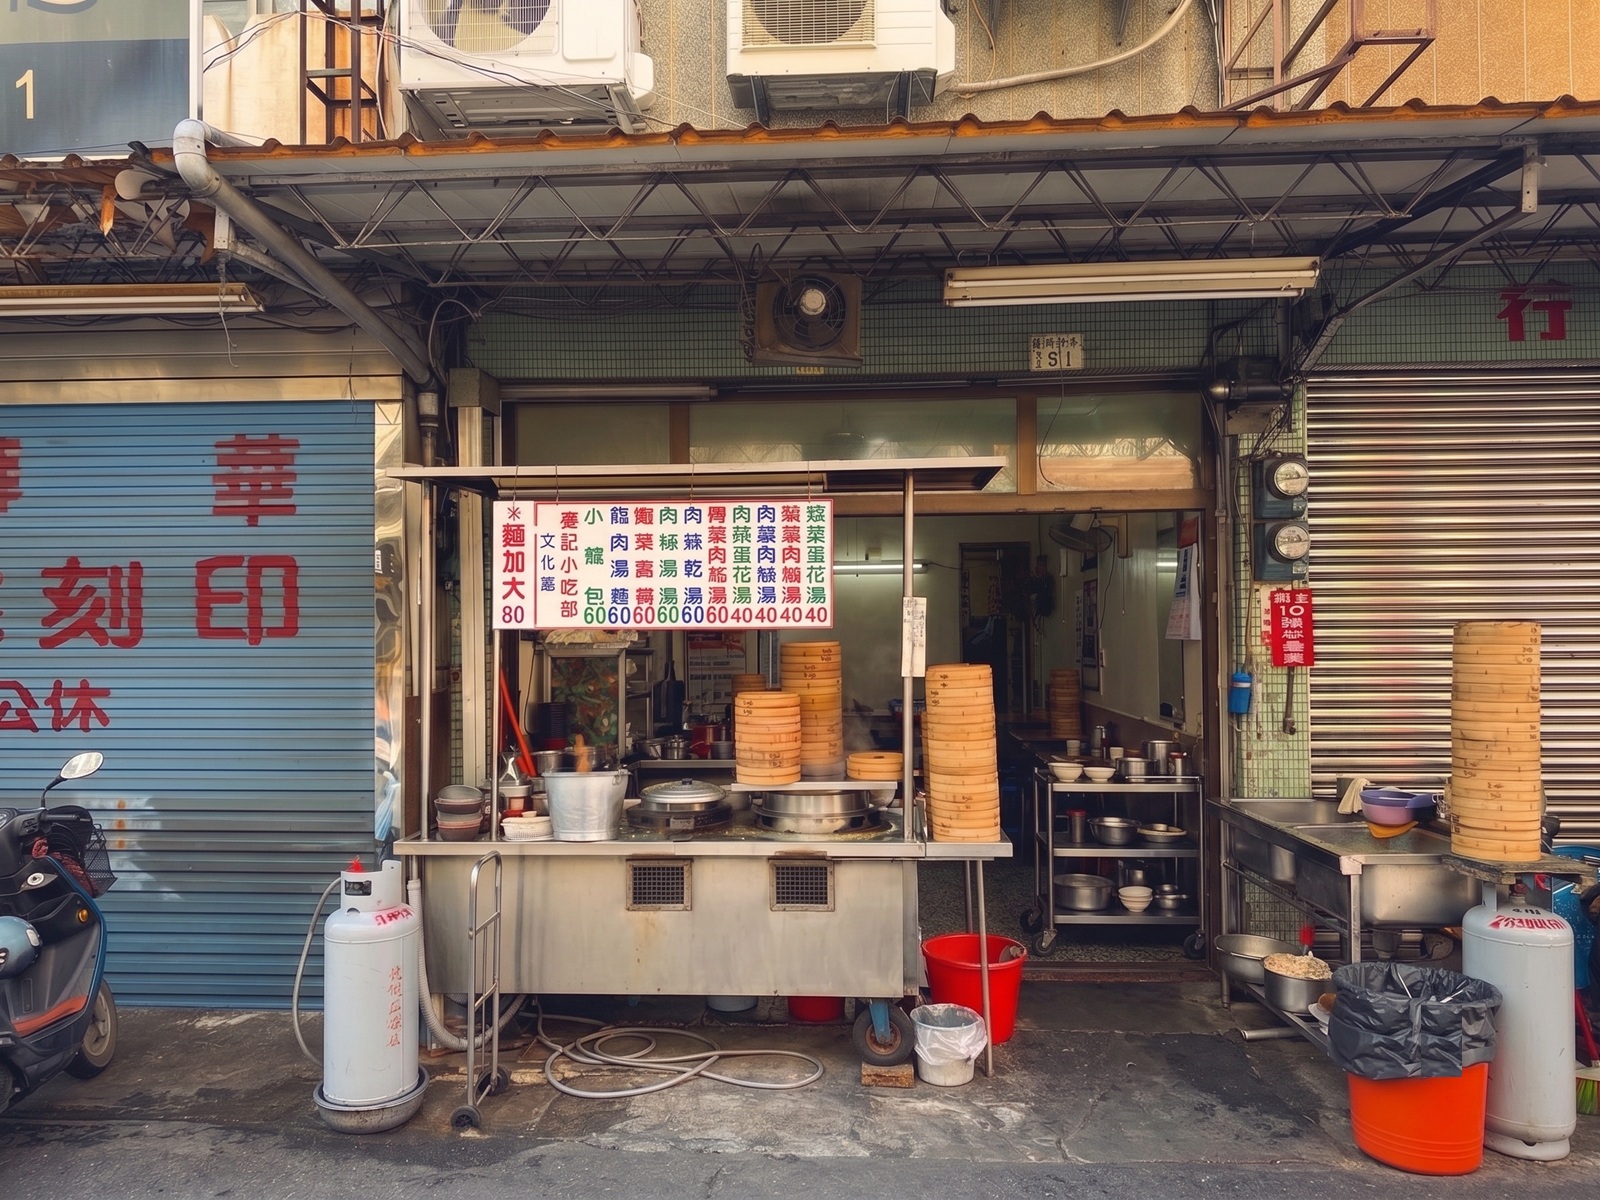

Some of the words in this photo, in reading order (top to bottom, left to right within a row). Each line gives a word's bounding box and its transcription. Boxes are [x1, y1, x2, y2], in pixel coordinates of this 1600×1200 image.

[15, 69, 34, 119] 1
[501, 605, 525, 624] 80
[584, 606, 607, 624] 60
[608, 606, 631, 624] 60
[633, 606, 656, 624] 60
[658, 606, 680, 624] 60
[682, 606, 705, 624] 60
[707, 606, 729, 624] 60
[731, 607, 753, 624] 40
[755, 607, 778, 624] 40
[780, 607, 803, 624] 40
[804, 607, 828, 624] 40
